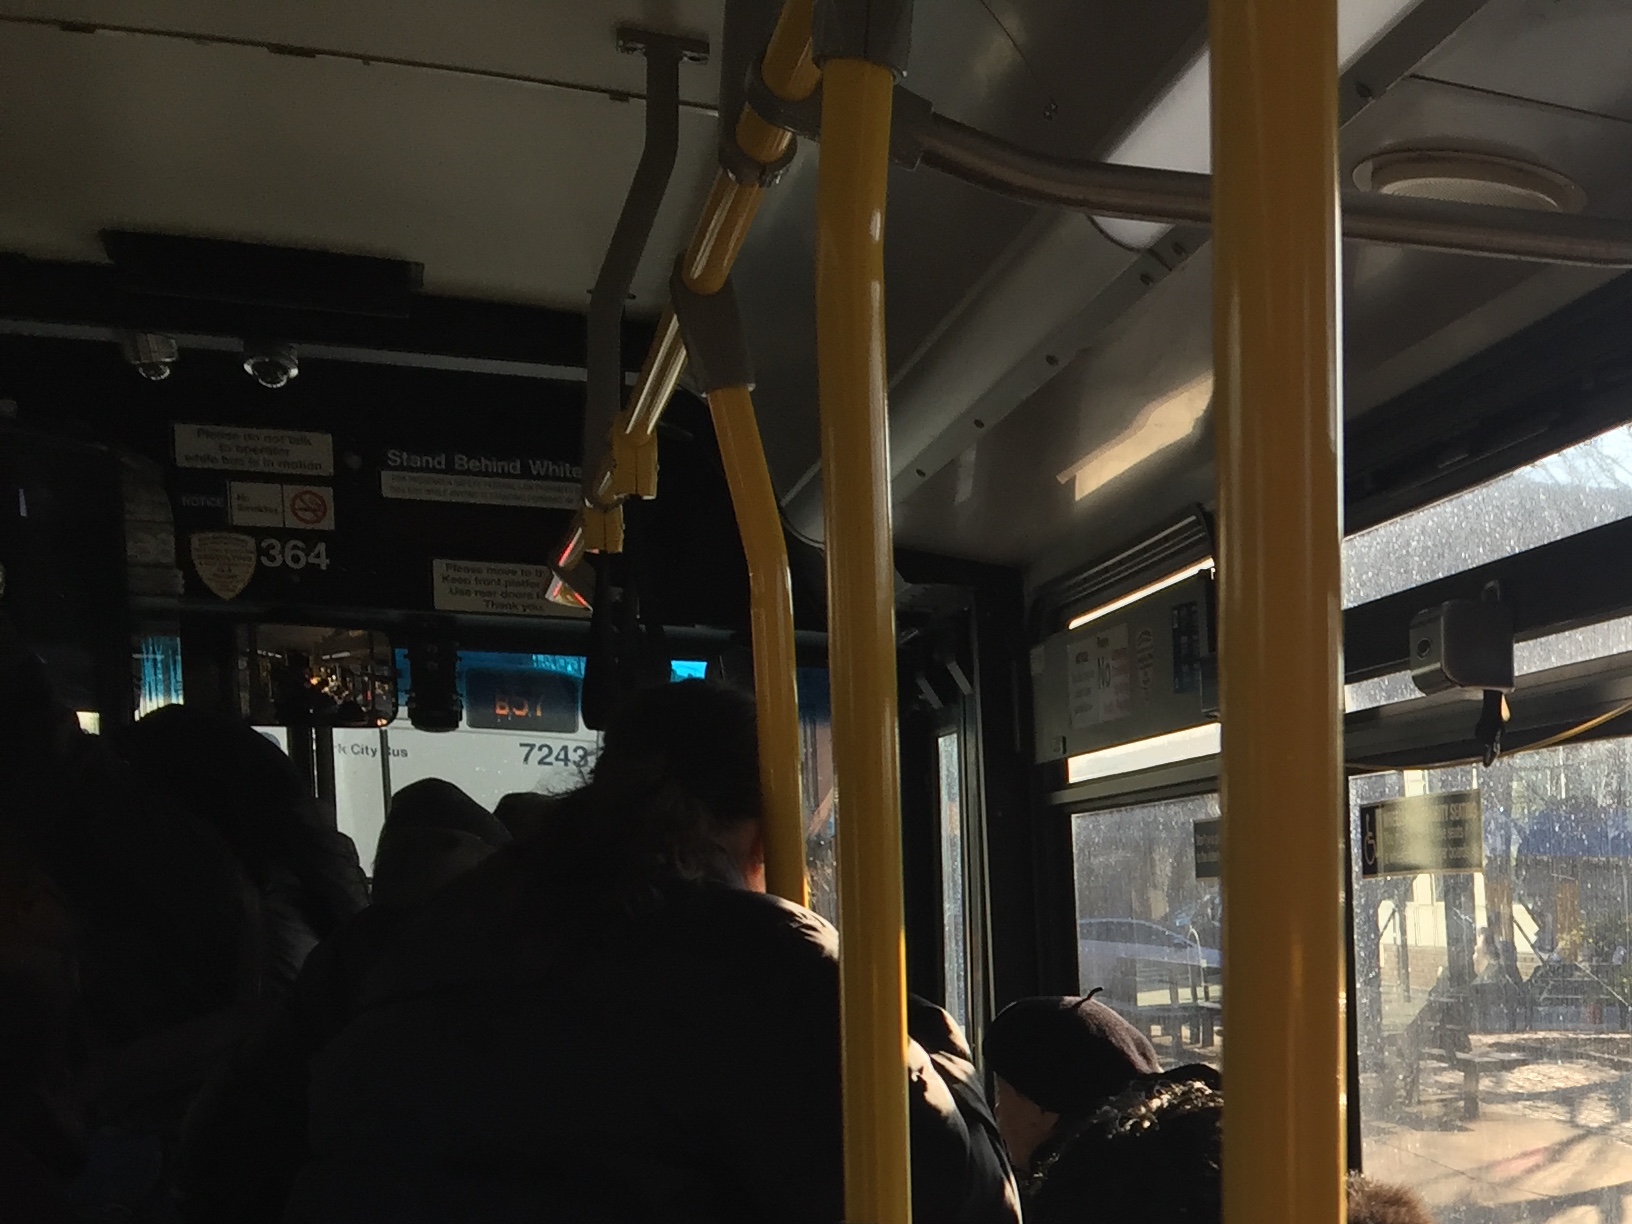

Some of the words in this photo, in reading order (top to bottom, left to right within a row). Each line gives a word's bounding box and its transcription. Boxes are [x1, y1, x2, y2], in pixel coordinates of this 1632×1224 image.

[386, 448, 446, 470] Stand
[454, 453, 521, 475] Behind
[528, 458, 582, 478] White
[260, 538, 330, 571] 364
[445, 562, 483, 574] Please
[483, 598, 519, 610] Thank
[350, 743, 378, 758] City
[518, 742, 589, 768] 7243
